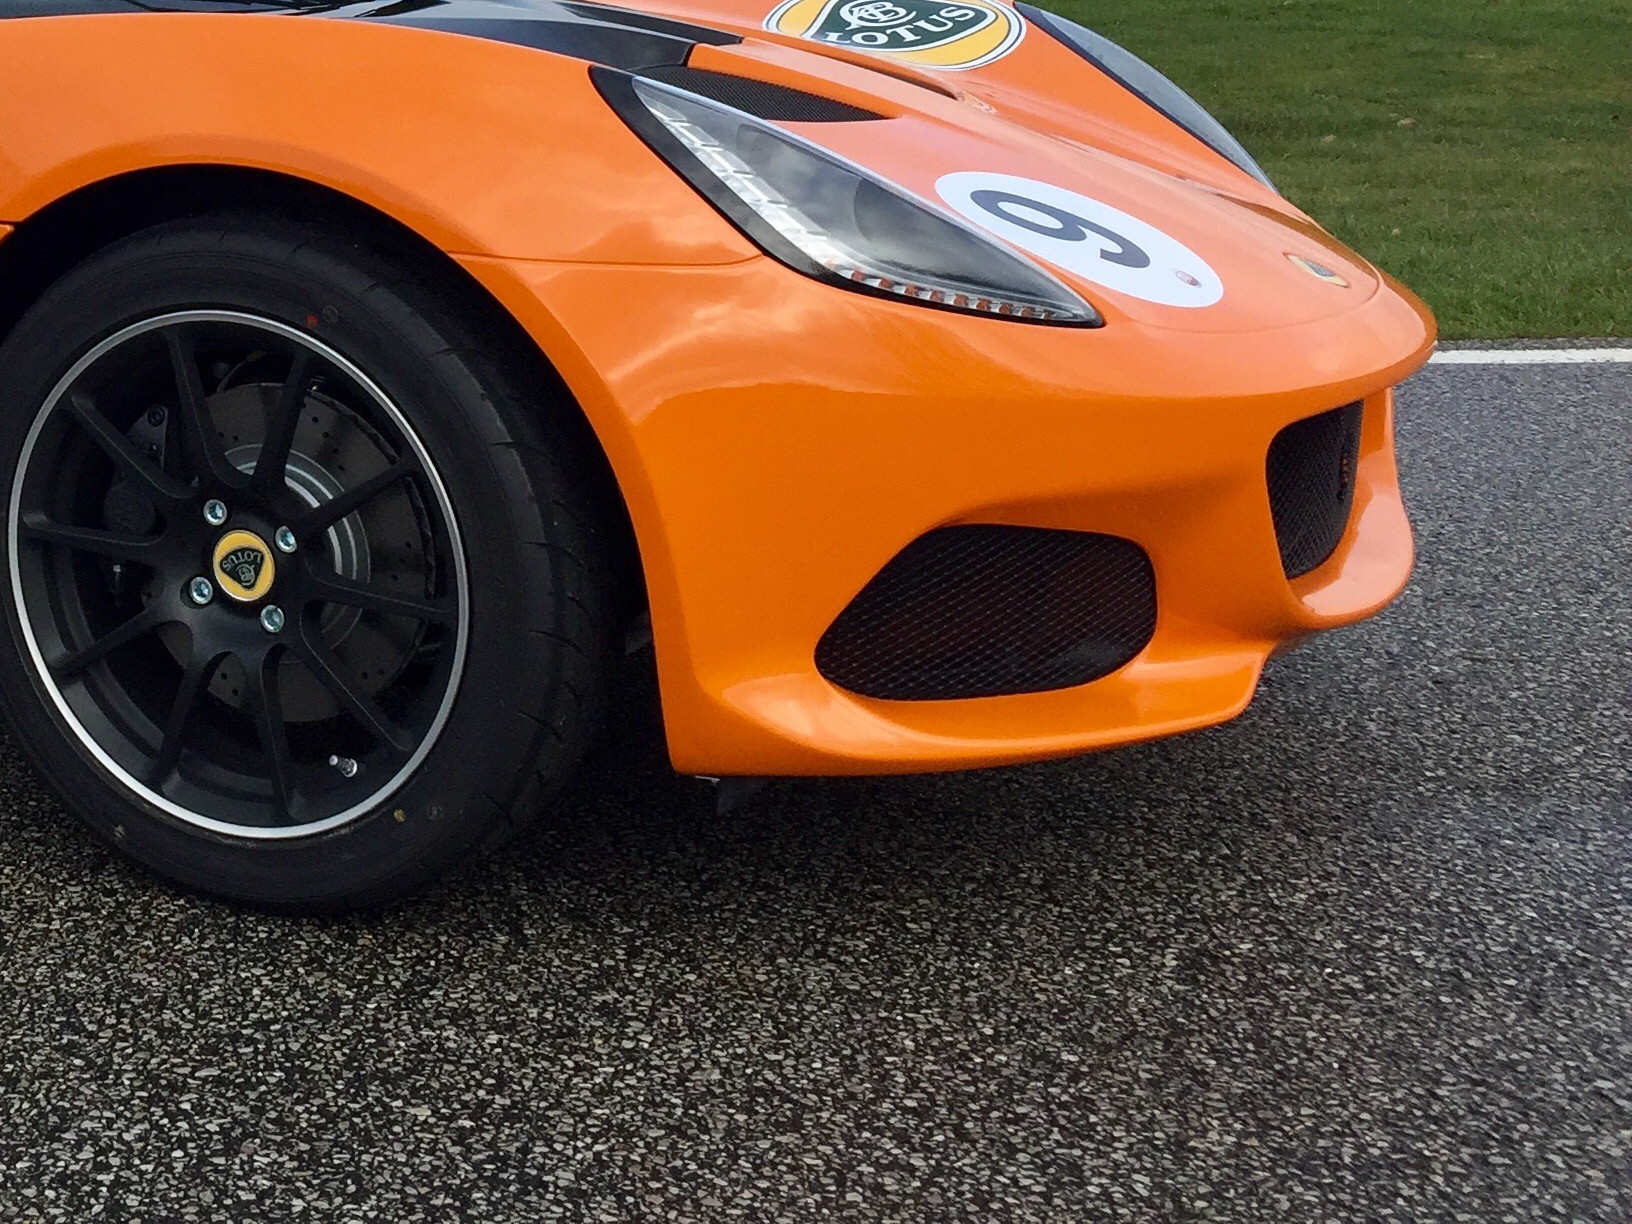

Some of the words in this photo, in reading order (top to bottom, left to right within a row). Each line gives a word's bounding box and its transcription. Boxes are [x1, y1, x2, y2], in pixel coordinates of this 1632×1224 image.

[824, 6, 975, 46] LOTUS
[970, 189, 1151, 269] 9
[222, 550, 262, 572] LOTUS
